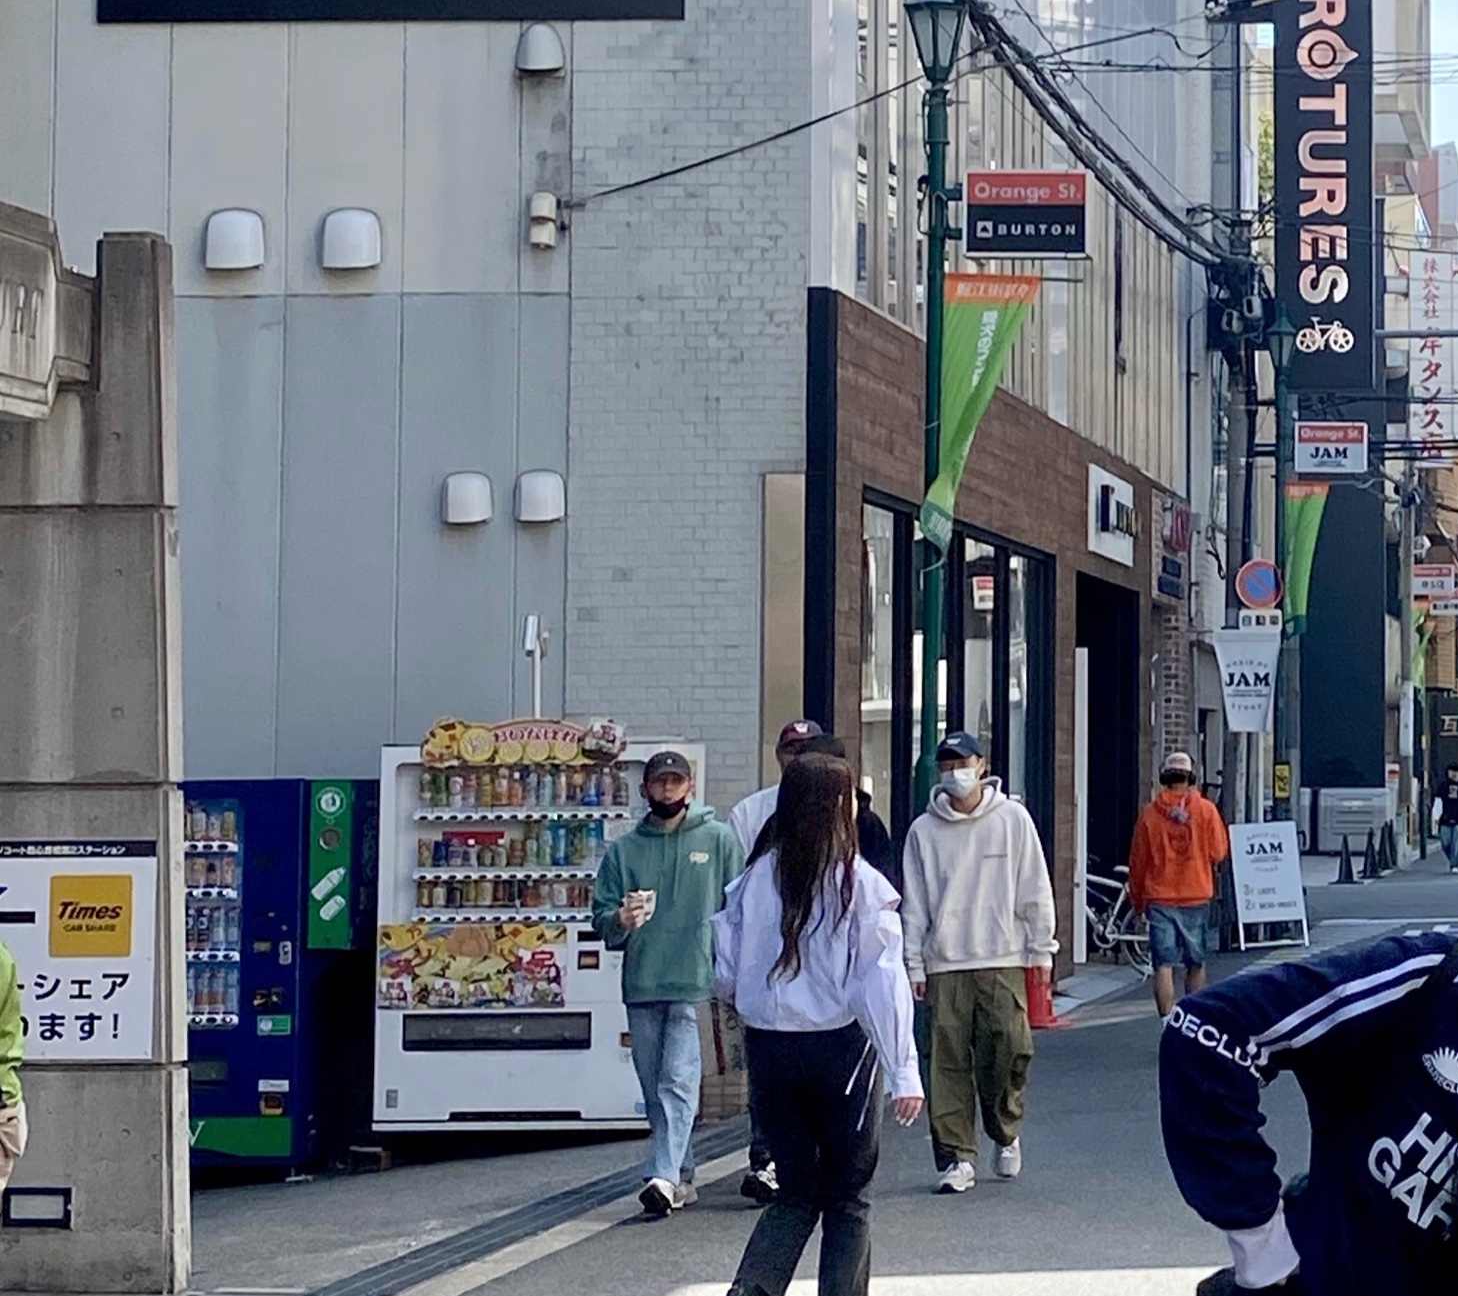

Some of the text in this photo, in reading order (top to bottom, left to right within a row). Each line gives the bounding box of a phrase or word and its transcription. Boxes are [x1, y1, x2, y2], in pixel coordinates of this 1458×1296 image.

[974, 181, 1082, 203] Orange St.
[997, 223, 1077, 236] BURTON
[1301, 427, 1344, 441] Orange
[1309, 446, 1349, 459] JAM
[1225, 671, 1271, 688] JAM
[1245, 841, 1284, 857] JAM
[58, 900, 124, 921] Times
